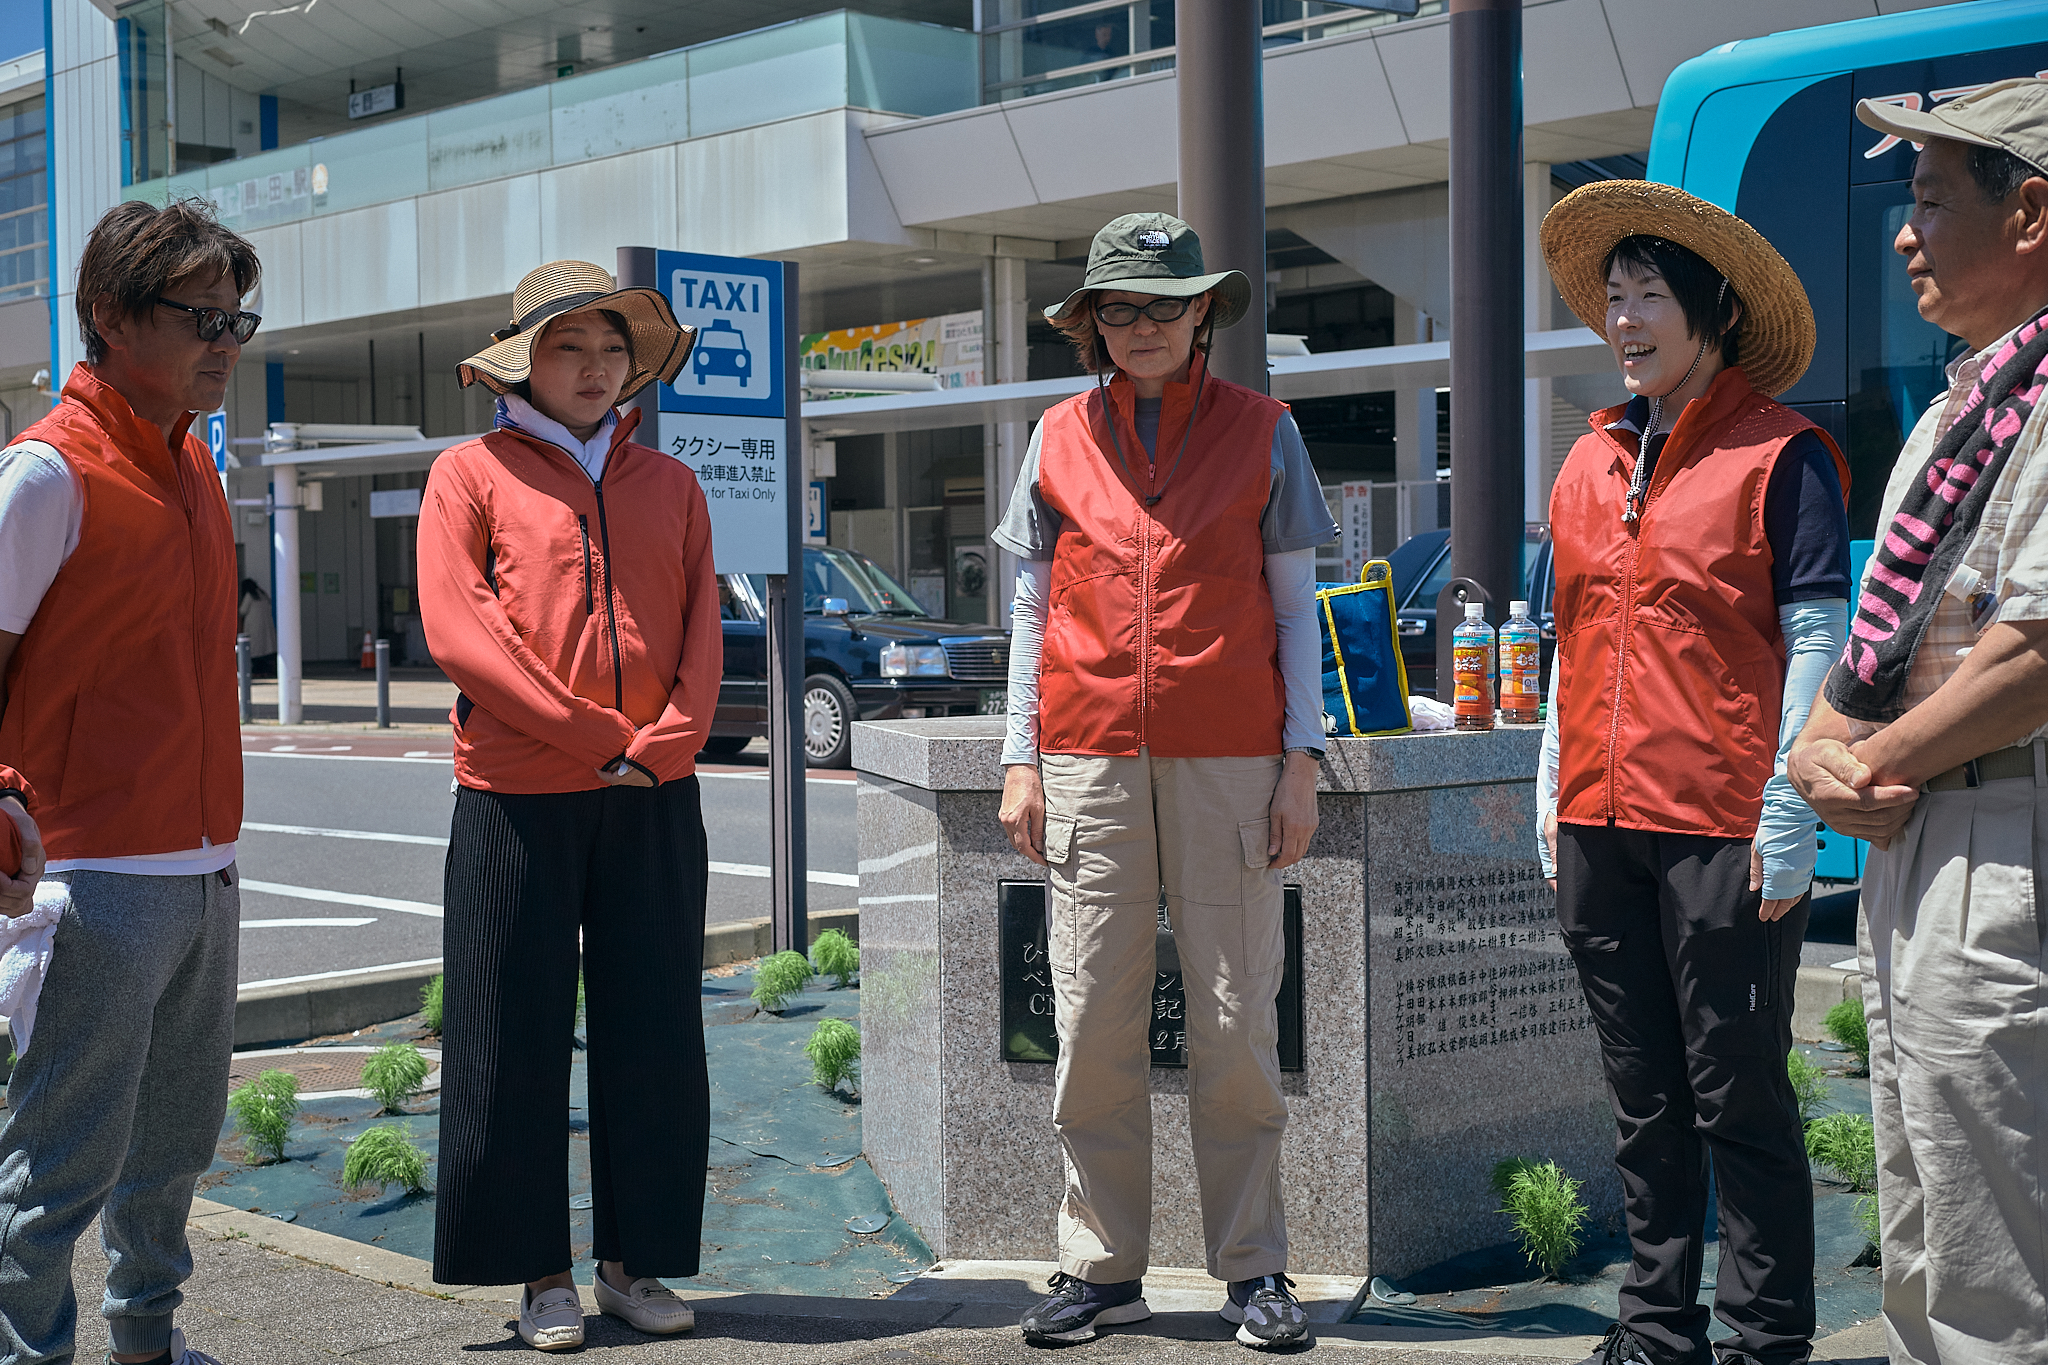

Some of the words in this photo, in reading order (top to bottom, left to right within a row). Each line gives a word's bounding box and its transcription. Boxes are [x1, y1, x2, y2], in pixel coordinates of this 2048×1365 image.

[680, 277, 760, 313] TAXI
[212, 420, 223, 465] P
[671, 435, 775, 461] タクシー専用
[711, 486, 726, 499] for
[728, 487, 750, 500] Taxi
[752, 488, 776, 503] Only
[1454, 655, 1483, 671] むぎ茶
[987, 700, 1008, 715] 27-
